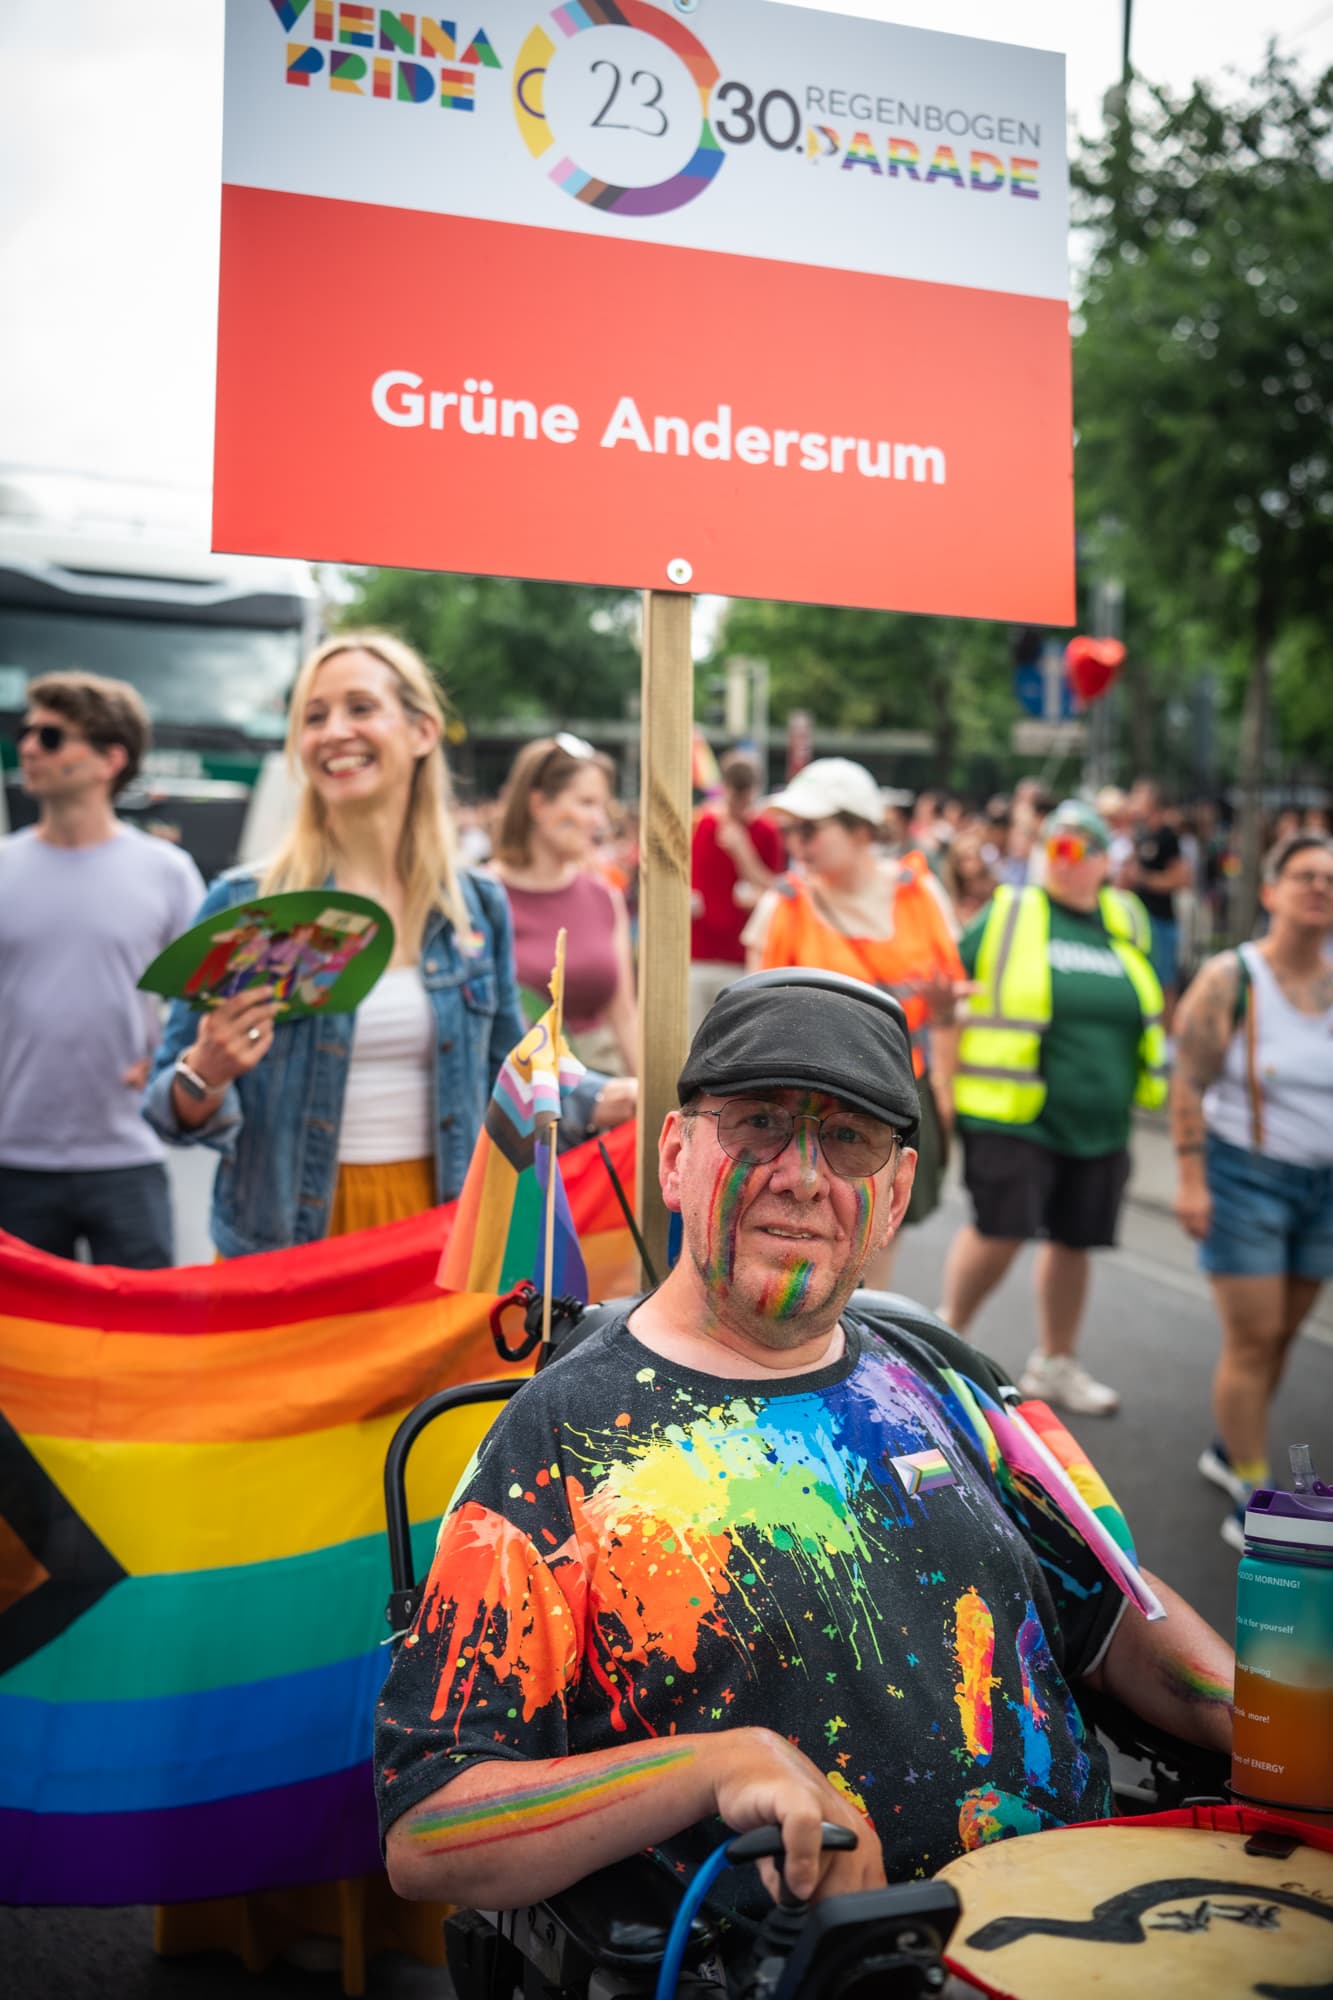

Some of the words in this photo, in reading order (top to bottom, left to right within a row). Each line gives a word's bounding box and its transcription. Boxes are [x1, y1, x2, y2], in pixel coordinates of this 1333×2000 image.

[270, 0, 502, 69] VIENNA
[285, 42, 475, 112] PRIDE
[590, 60, 668, 137] 23
[805, 86, 1040, 148] REGENBOGEN
[806, 125, 1040, 200] PARADE
[371, 369, 580, 443] Grüne
[600, 396, 946, 484] Andersrum
[1255, 1574, 1300, 1589] MORNING!
[1260, 1623, 1294, 1634] yourself
[1248, 1712, 1270, 1724] more!
[1251, 1759, 1284, 1774] ENERGY
